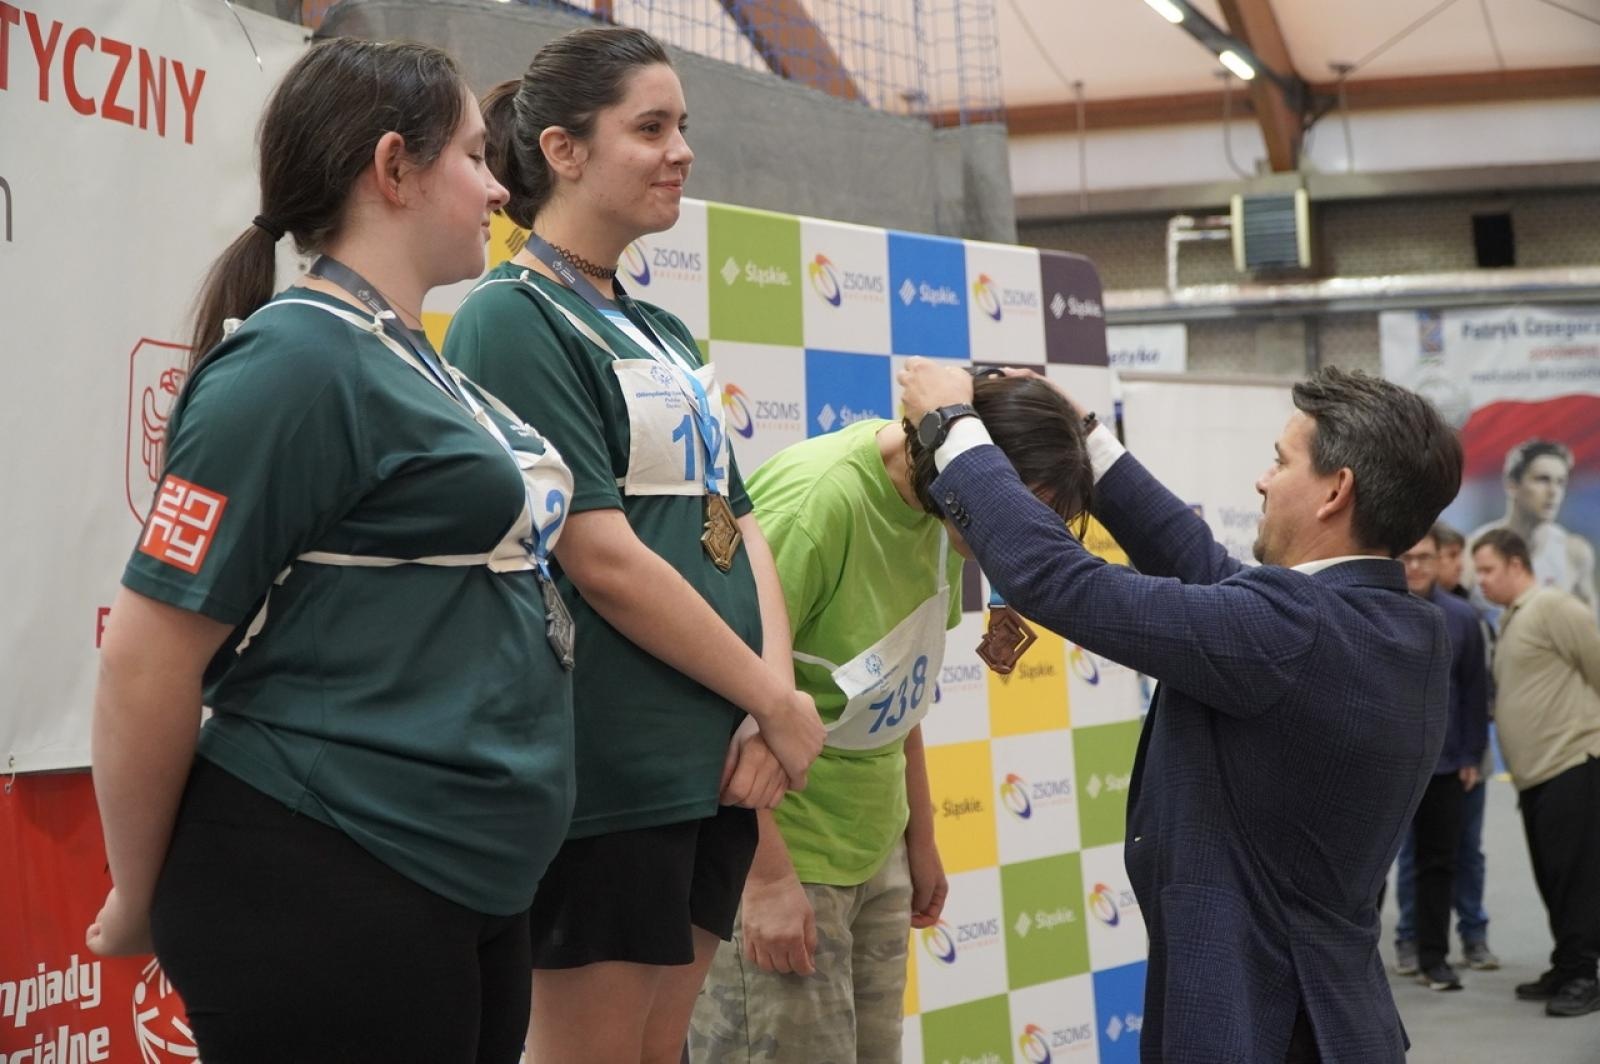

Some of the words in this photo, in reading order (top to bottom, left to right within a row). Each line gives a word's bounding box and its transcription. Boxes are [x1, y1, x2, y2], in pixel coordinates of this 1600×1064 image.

[653, 247, 702, 272] ZSOMS
[842, 271, 884, 293] ZSOMS
[755, 401, 800, 421] ZSOMS
[942, 664, 982, 684] ZSOMS
[868, 654, 929, 734] 738
[1032, 778, 1071, 800] ZSOMS
[957, 918, 998, 943] ZSOMS
[1052, 1023, 1092, 1048] ZSOMS
